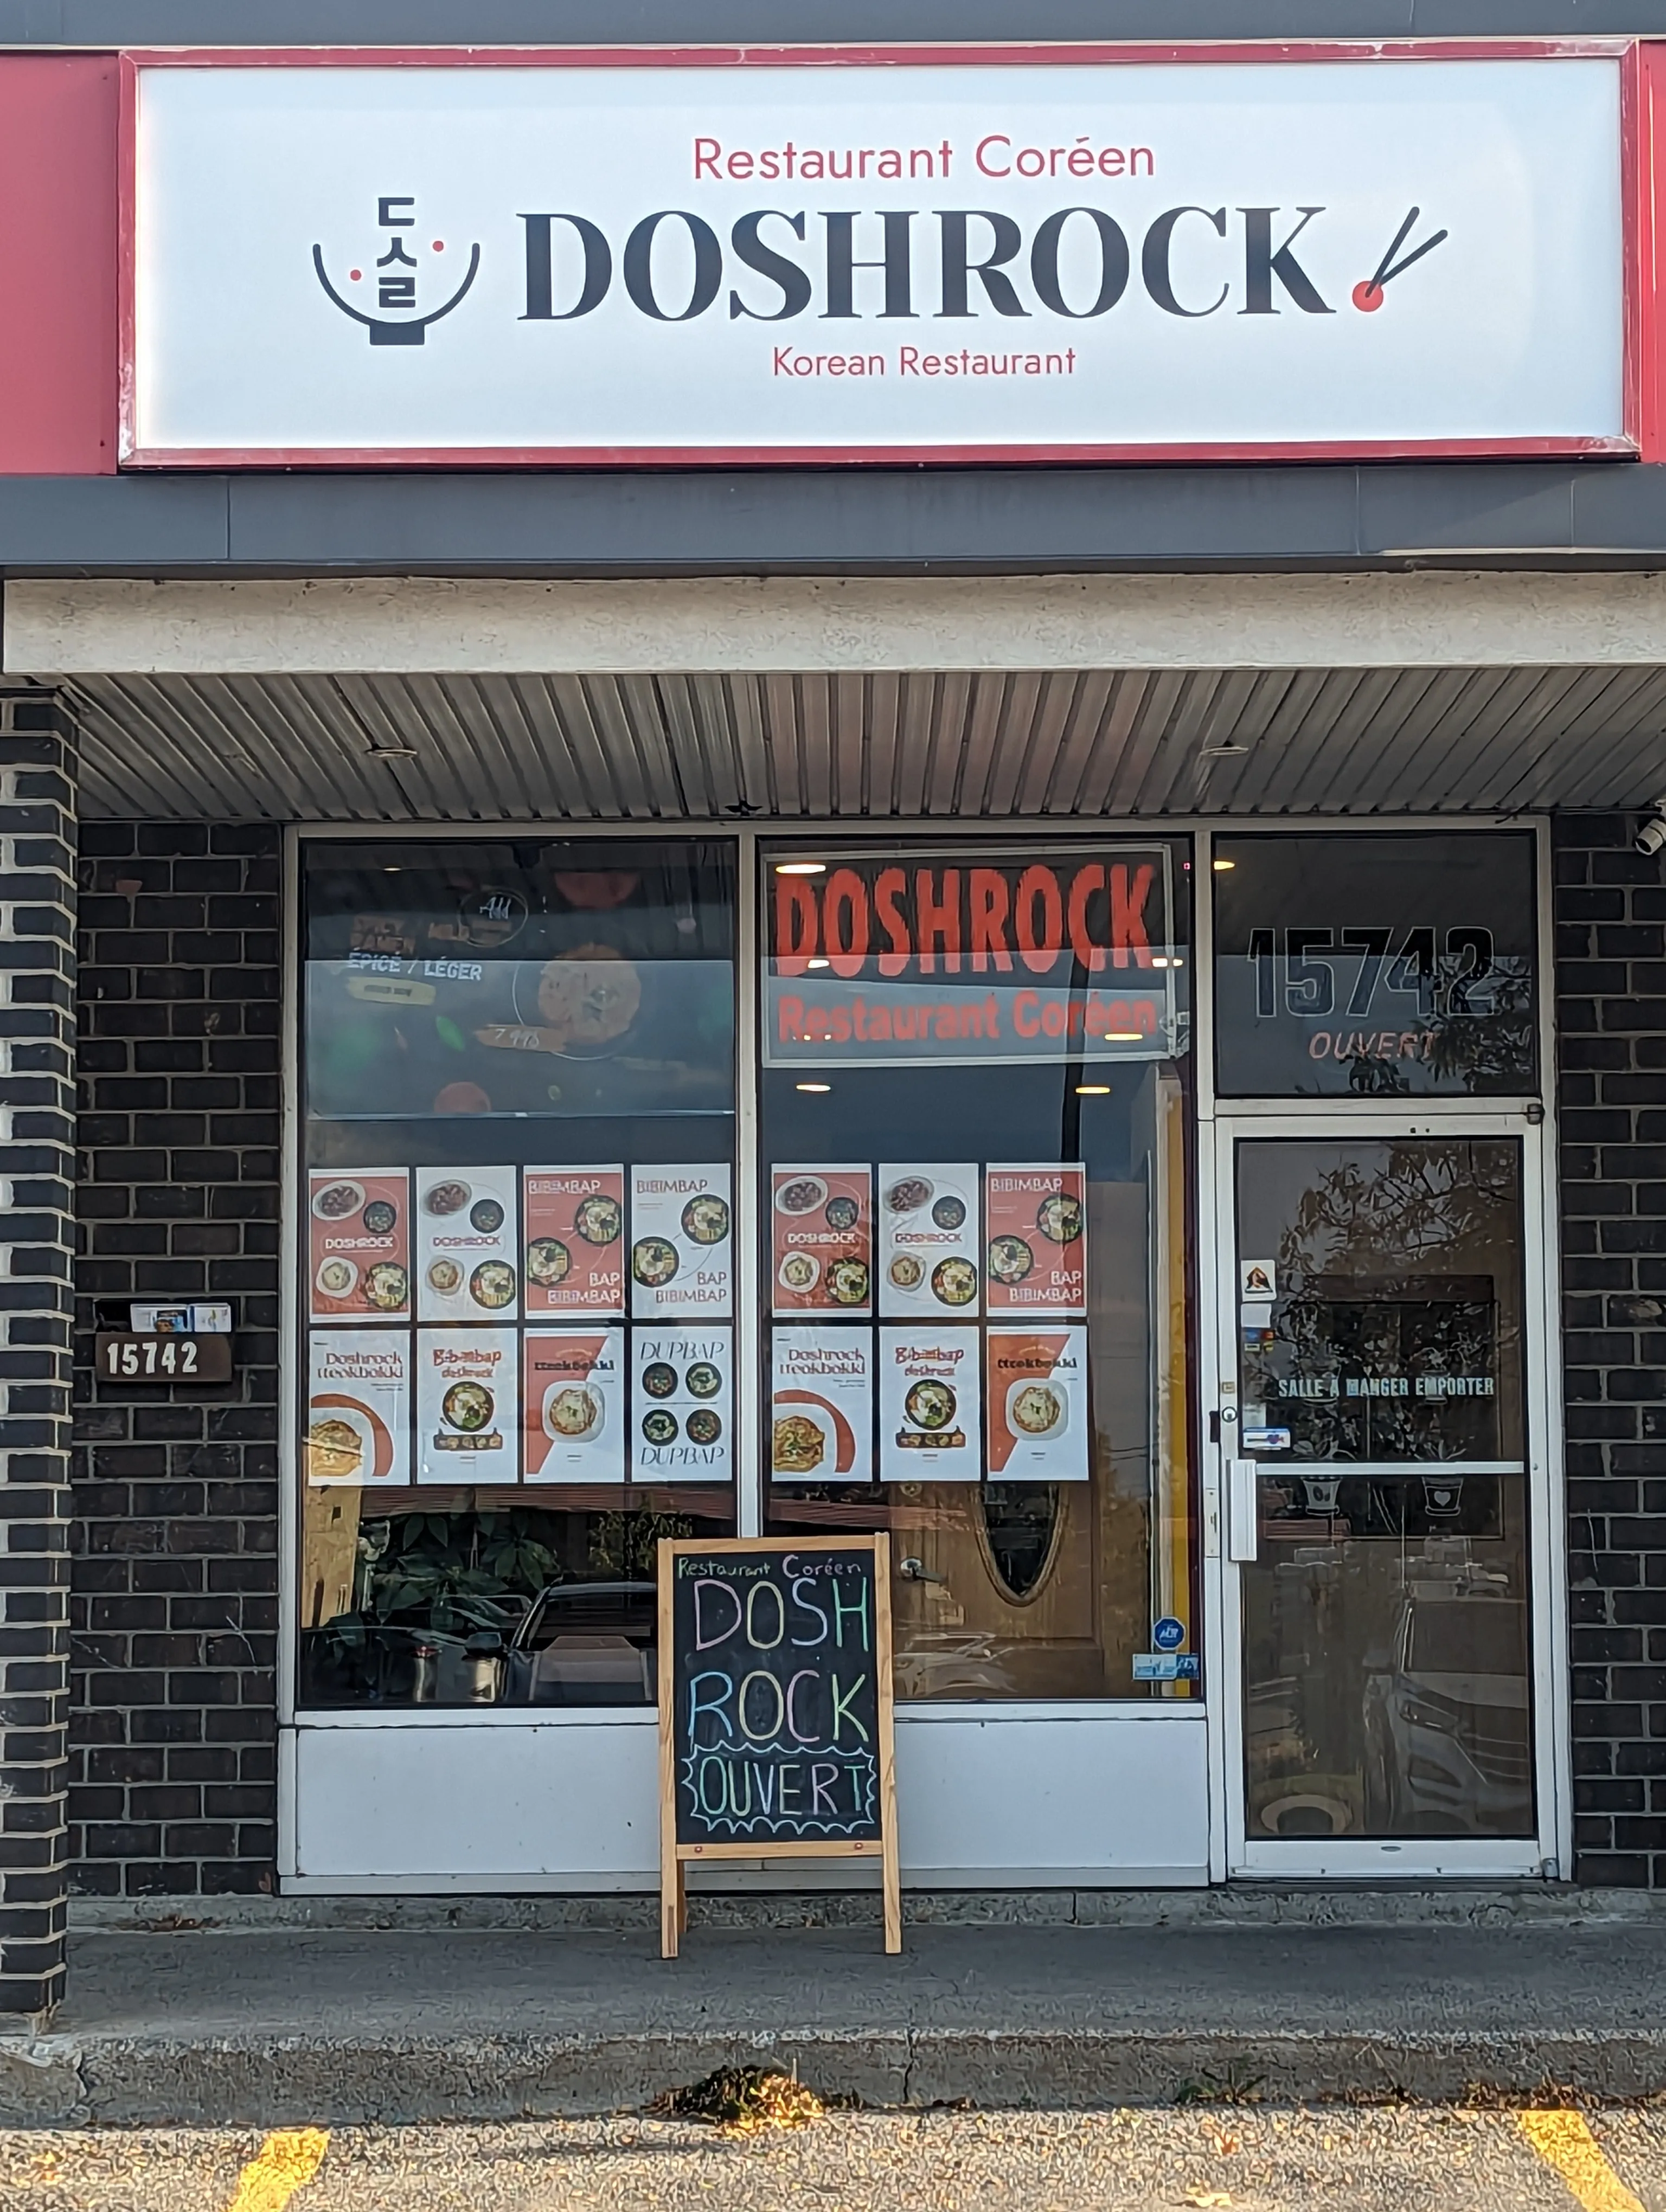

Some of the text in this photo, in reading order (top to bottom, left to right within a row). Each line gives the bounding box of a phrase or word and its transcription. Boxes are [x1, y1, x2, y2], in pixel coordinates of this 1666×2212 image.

[694, 136, 1155, 179] Restaurant Coréen
[516, 207, 1336, 321] DOSHROCK
[774, 346, 1076, 377] Korean Restaurant
[776, 864, 1156, 977] DOSHROCK
[424, 956, 482, 980] LÉGER
[1247, 926, 1496, 1018] 15742
[778, 991, 1157, 1043] Restaurant Coréen
[1309, 1031, 1440, 1060] OUVERT
[528, 1180, 601, 1194] BIBIMBAP
[637, 1179, 708, 1193] BIBIMBAP
[990, 1178, 1063, 1192] BIBIMBAP
[589, 1272, 620, 1287] BAP
[697, 1272, 727, 1285] BAP
[1051, 1271, 1082, 1285] BAP
[548, 1290, 620, 1304] BIBIMBAP
[656, 1289, 727, 1303] BIBIMBAP
[1009, 1288, 1082, 1302] BIBIMBAP
[107, 1341, 197, 1375] 15742
[640, 1341, 725, 1360] DUPBAP
[1278, 1379, 1323, 1397] SALLE
[1346, 1378, 1408, 1397] MANGER
[1415, 1377, 1494, 1396] EMPORTER
[640, 1446, 725, 1466] DUPBAP
[678, 1554, 861, 1579] Restaurant Coréen
[694, 1577, 869, 1652] DOSH
[688, 1669, 869, 1742] ROCK
[699, 1756, 866, 1816] OUVERT
